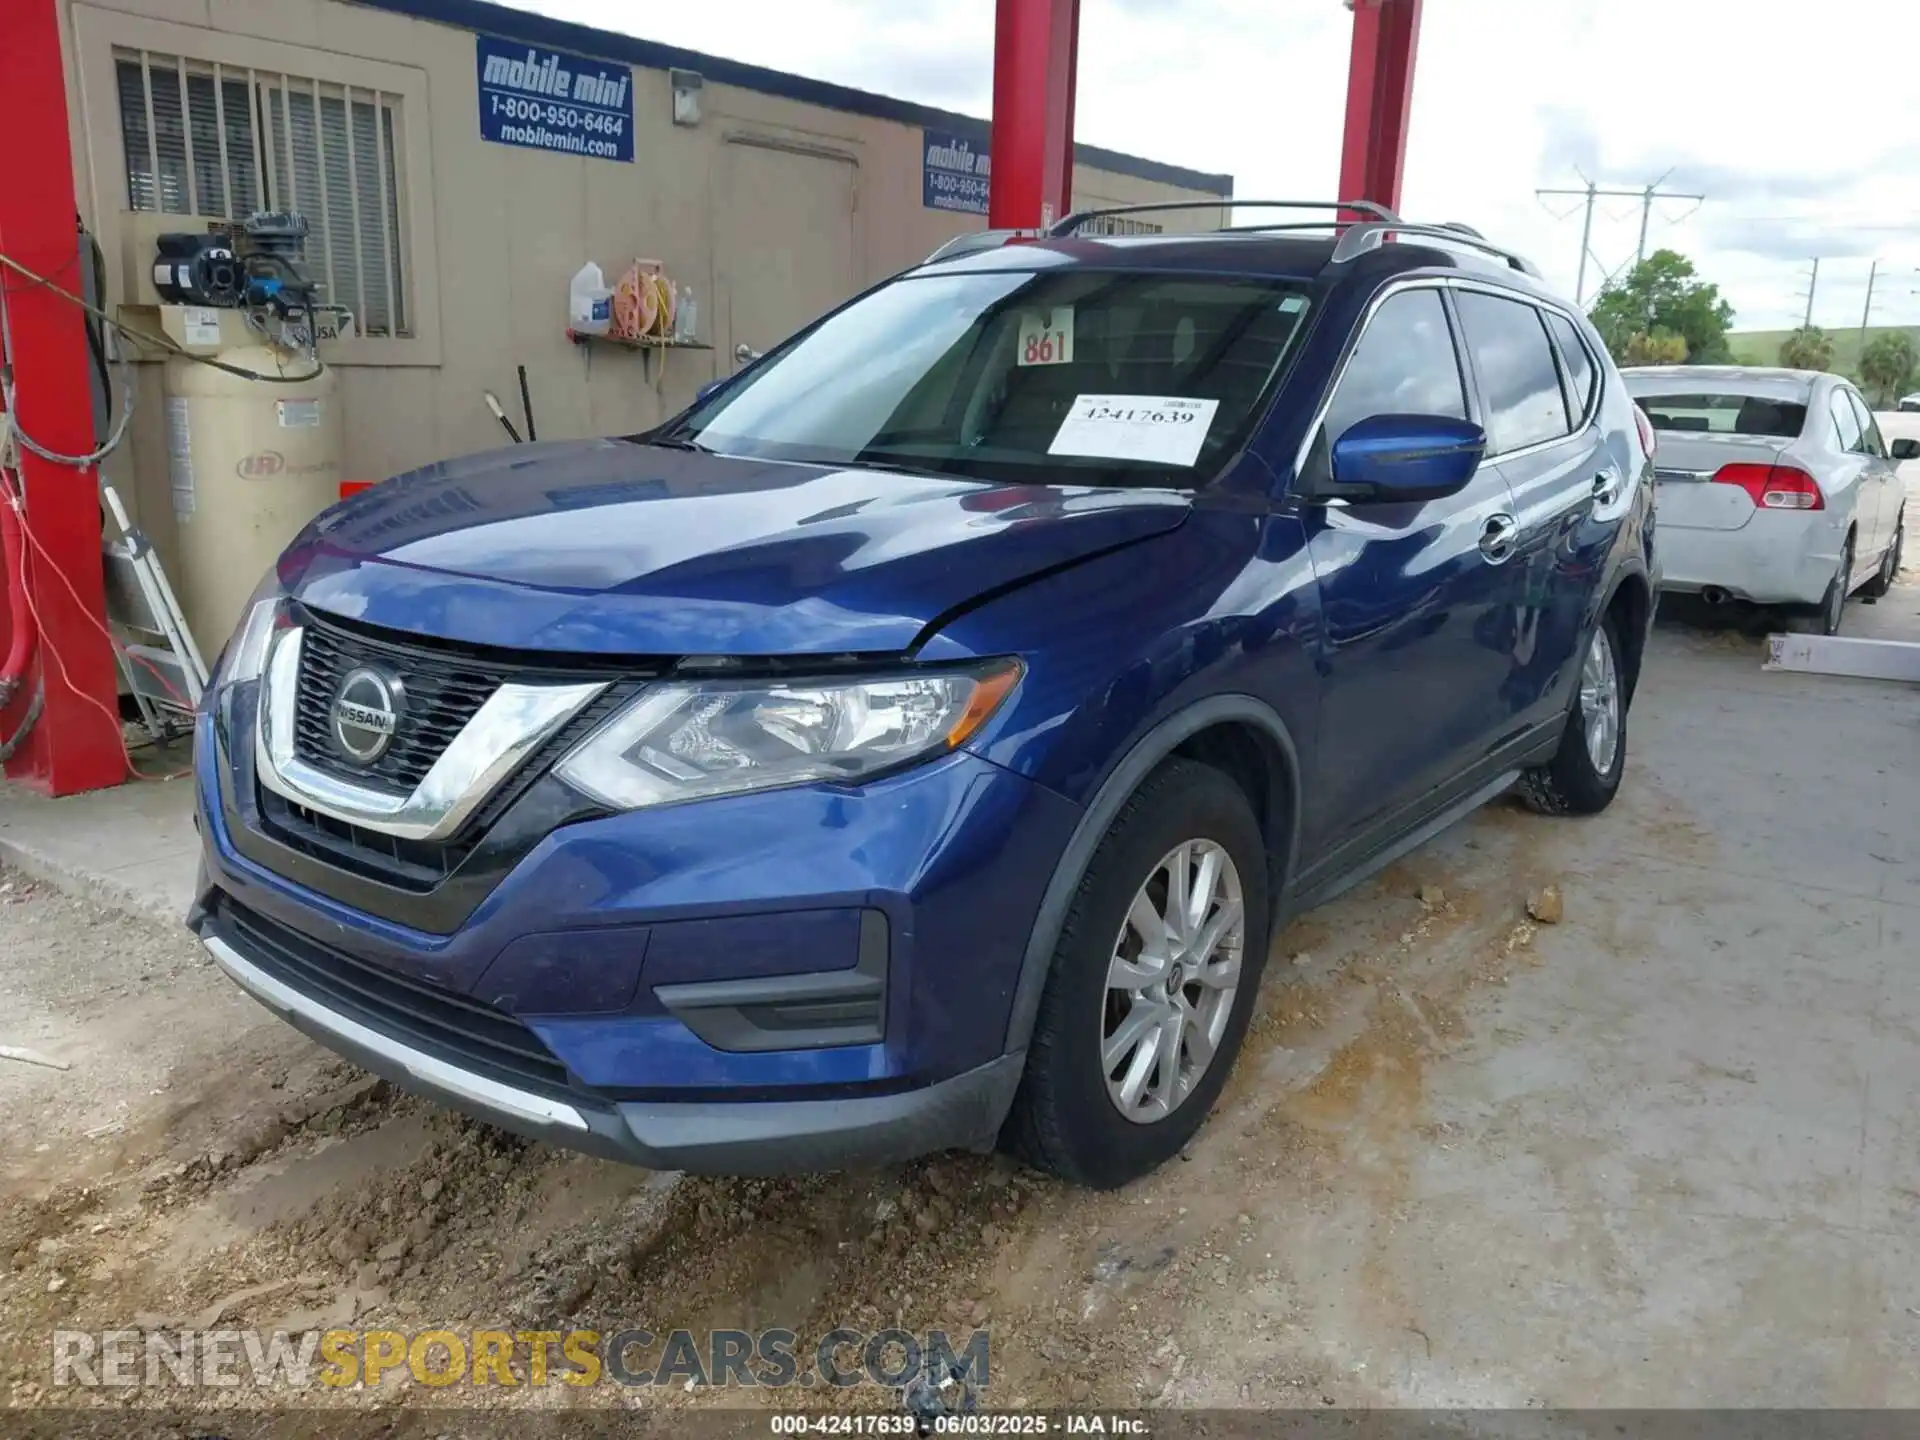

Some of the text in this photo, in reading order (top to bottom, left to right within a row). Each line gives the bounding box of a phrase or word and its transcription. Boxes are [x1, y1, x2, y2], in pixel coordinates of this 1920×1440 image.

[484, 49, 628, 108] mobile mini
[491, 95, 623, 136] 1-800-950-6464
[501, 125, 617, 157] mobilemini.com
[926, 140, 975, 173] mobile
[1024, 331, 1064, 363] 861
[1084, 407, 1194, 424] 42417639
[340, 705, 386, 728] NISSAN
